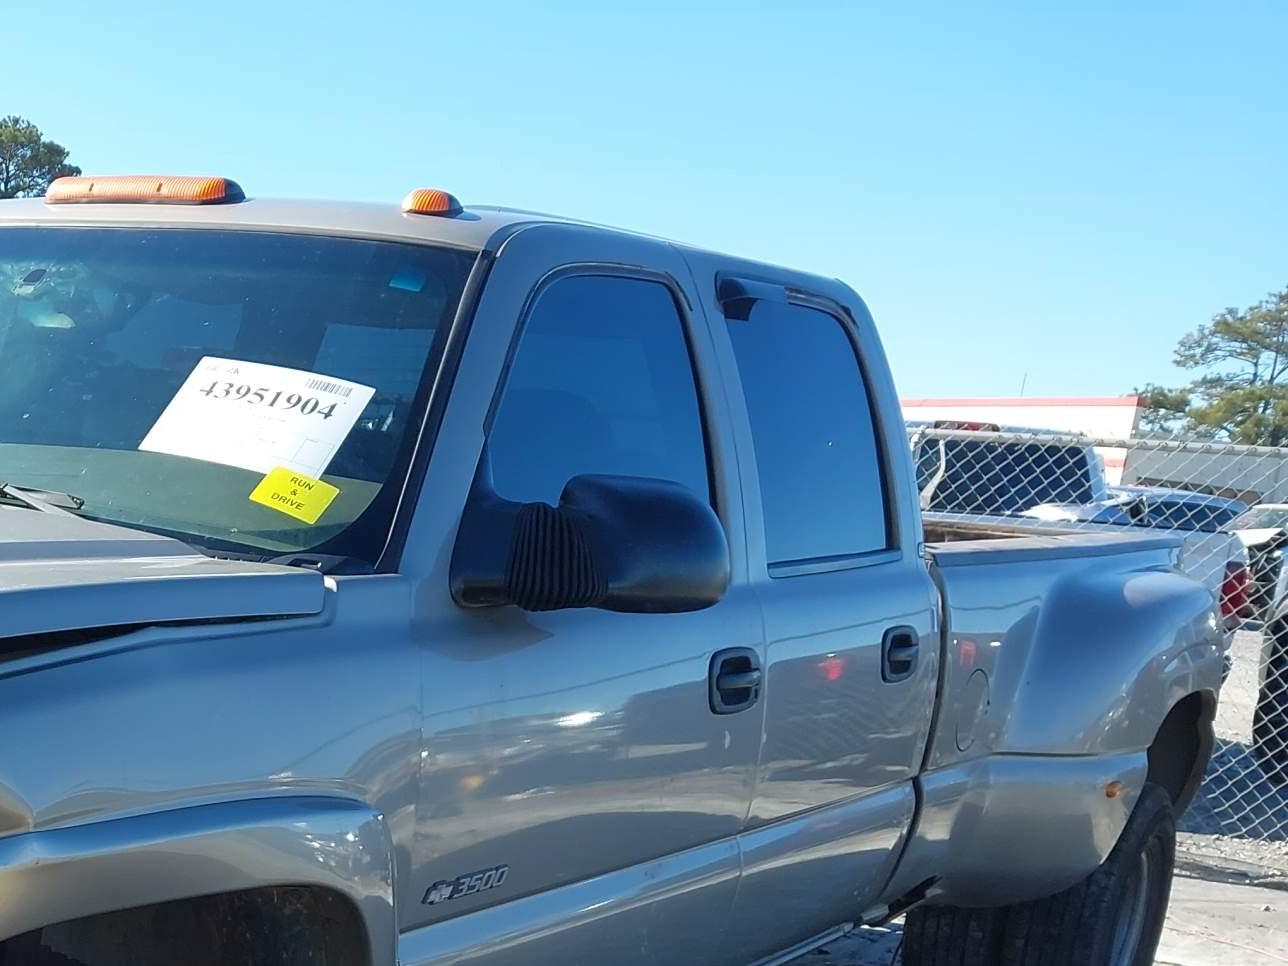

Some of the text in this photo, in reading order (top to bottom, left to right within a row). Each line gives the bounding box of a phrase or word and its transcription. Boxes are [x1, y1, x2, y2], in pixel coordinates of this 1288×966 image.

[199, 379, 338, 420] 43951904
[289, 476, 314, 491] RUN
[290, 488, 299, 497] &
[271, 492, 305, 511] DRIVE
[452, 864, 510, 898] 3500
